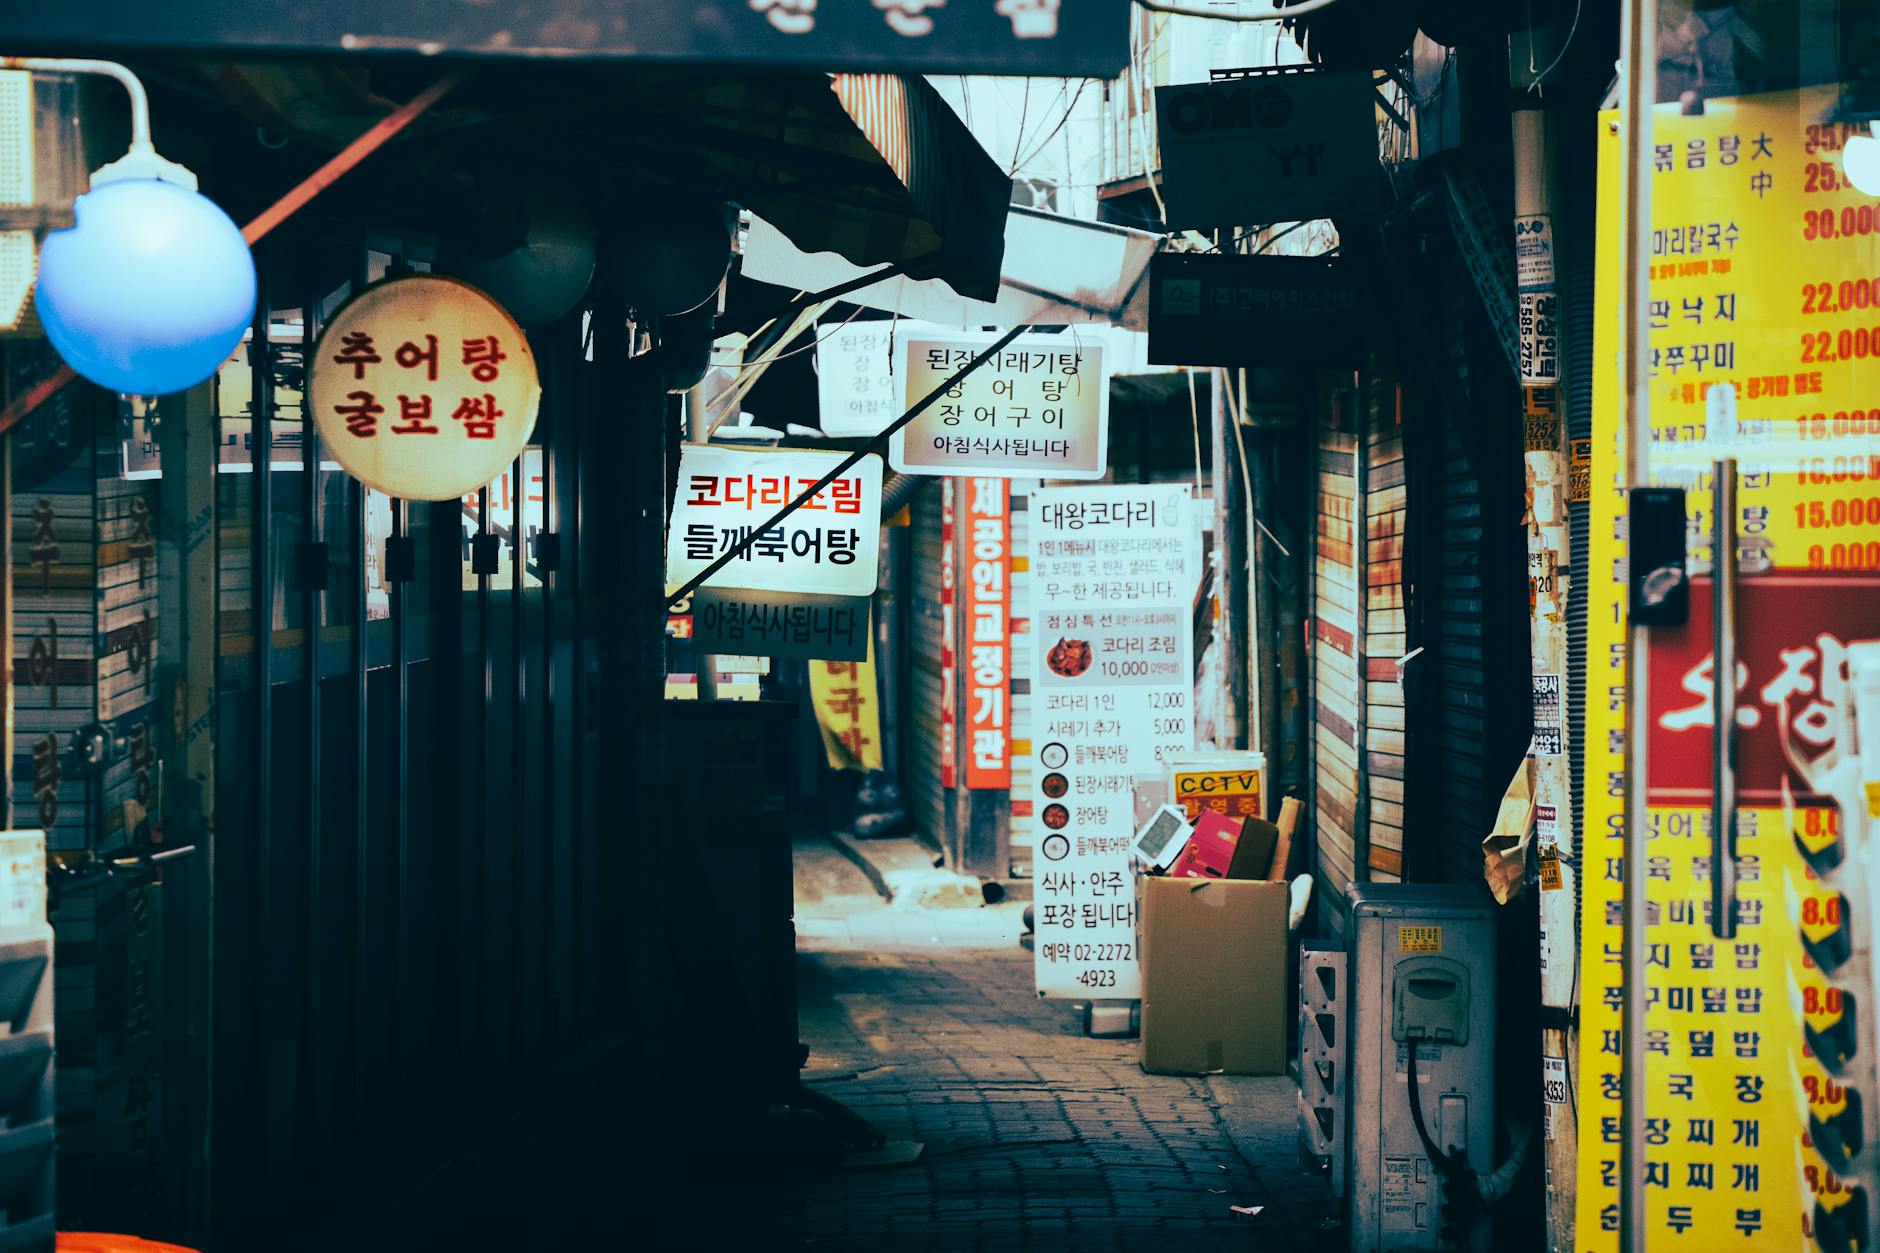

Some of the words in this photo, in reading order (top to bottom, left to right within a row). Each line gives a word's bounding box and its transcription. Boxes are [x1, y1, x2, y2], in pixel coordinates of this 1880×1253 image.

[1520, 308, 1532, 377] 585-2757
[333, 331, 507, 383] 추어탕
[334, 390, 504, 439] 굴보쌈
[939, 404, 1064, 429] 장어구이
[933, 436, 1070, 457] 아침식사됩니다
[687, 473, 861, 514] 코다리조림
[1042, 500, 1155, 530] 대왕코다리
[684, 524, 860, 564] 들깨북어탕
[1093, 581, 1177, 600] 제공됩니다.
[704, 602, 856, 645] 아침식사됩니다
[971, 479, 1004, 769] 제공인교정기관
[1102, 637, 1144, 654] 코다리
[1148, 636, 1176, 653] 조림
[1101, 661, 1149, 678] 10,000
[1047, 694, 1088, 712] 코다리
[1094, 694, 1115, 711] 1인
[1148, 692, 1185, 710] 12,000
[1093, 720, 1121, 737] 추가
[1154, 718, 1185, 736] 5,000
[1075, 744, 1129, 764] 들깨북어탕
[1181, 776, 1253, 793] CCTV
[1076, 807, 1108, 825] 장어탕
[1042, 903, 1076, 928] 포장
[1043, 943, 1070, 963] 예약
[1075, 944, 1131, 961] 02-2272
[1076, 970, 1115, 987] -4923
